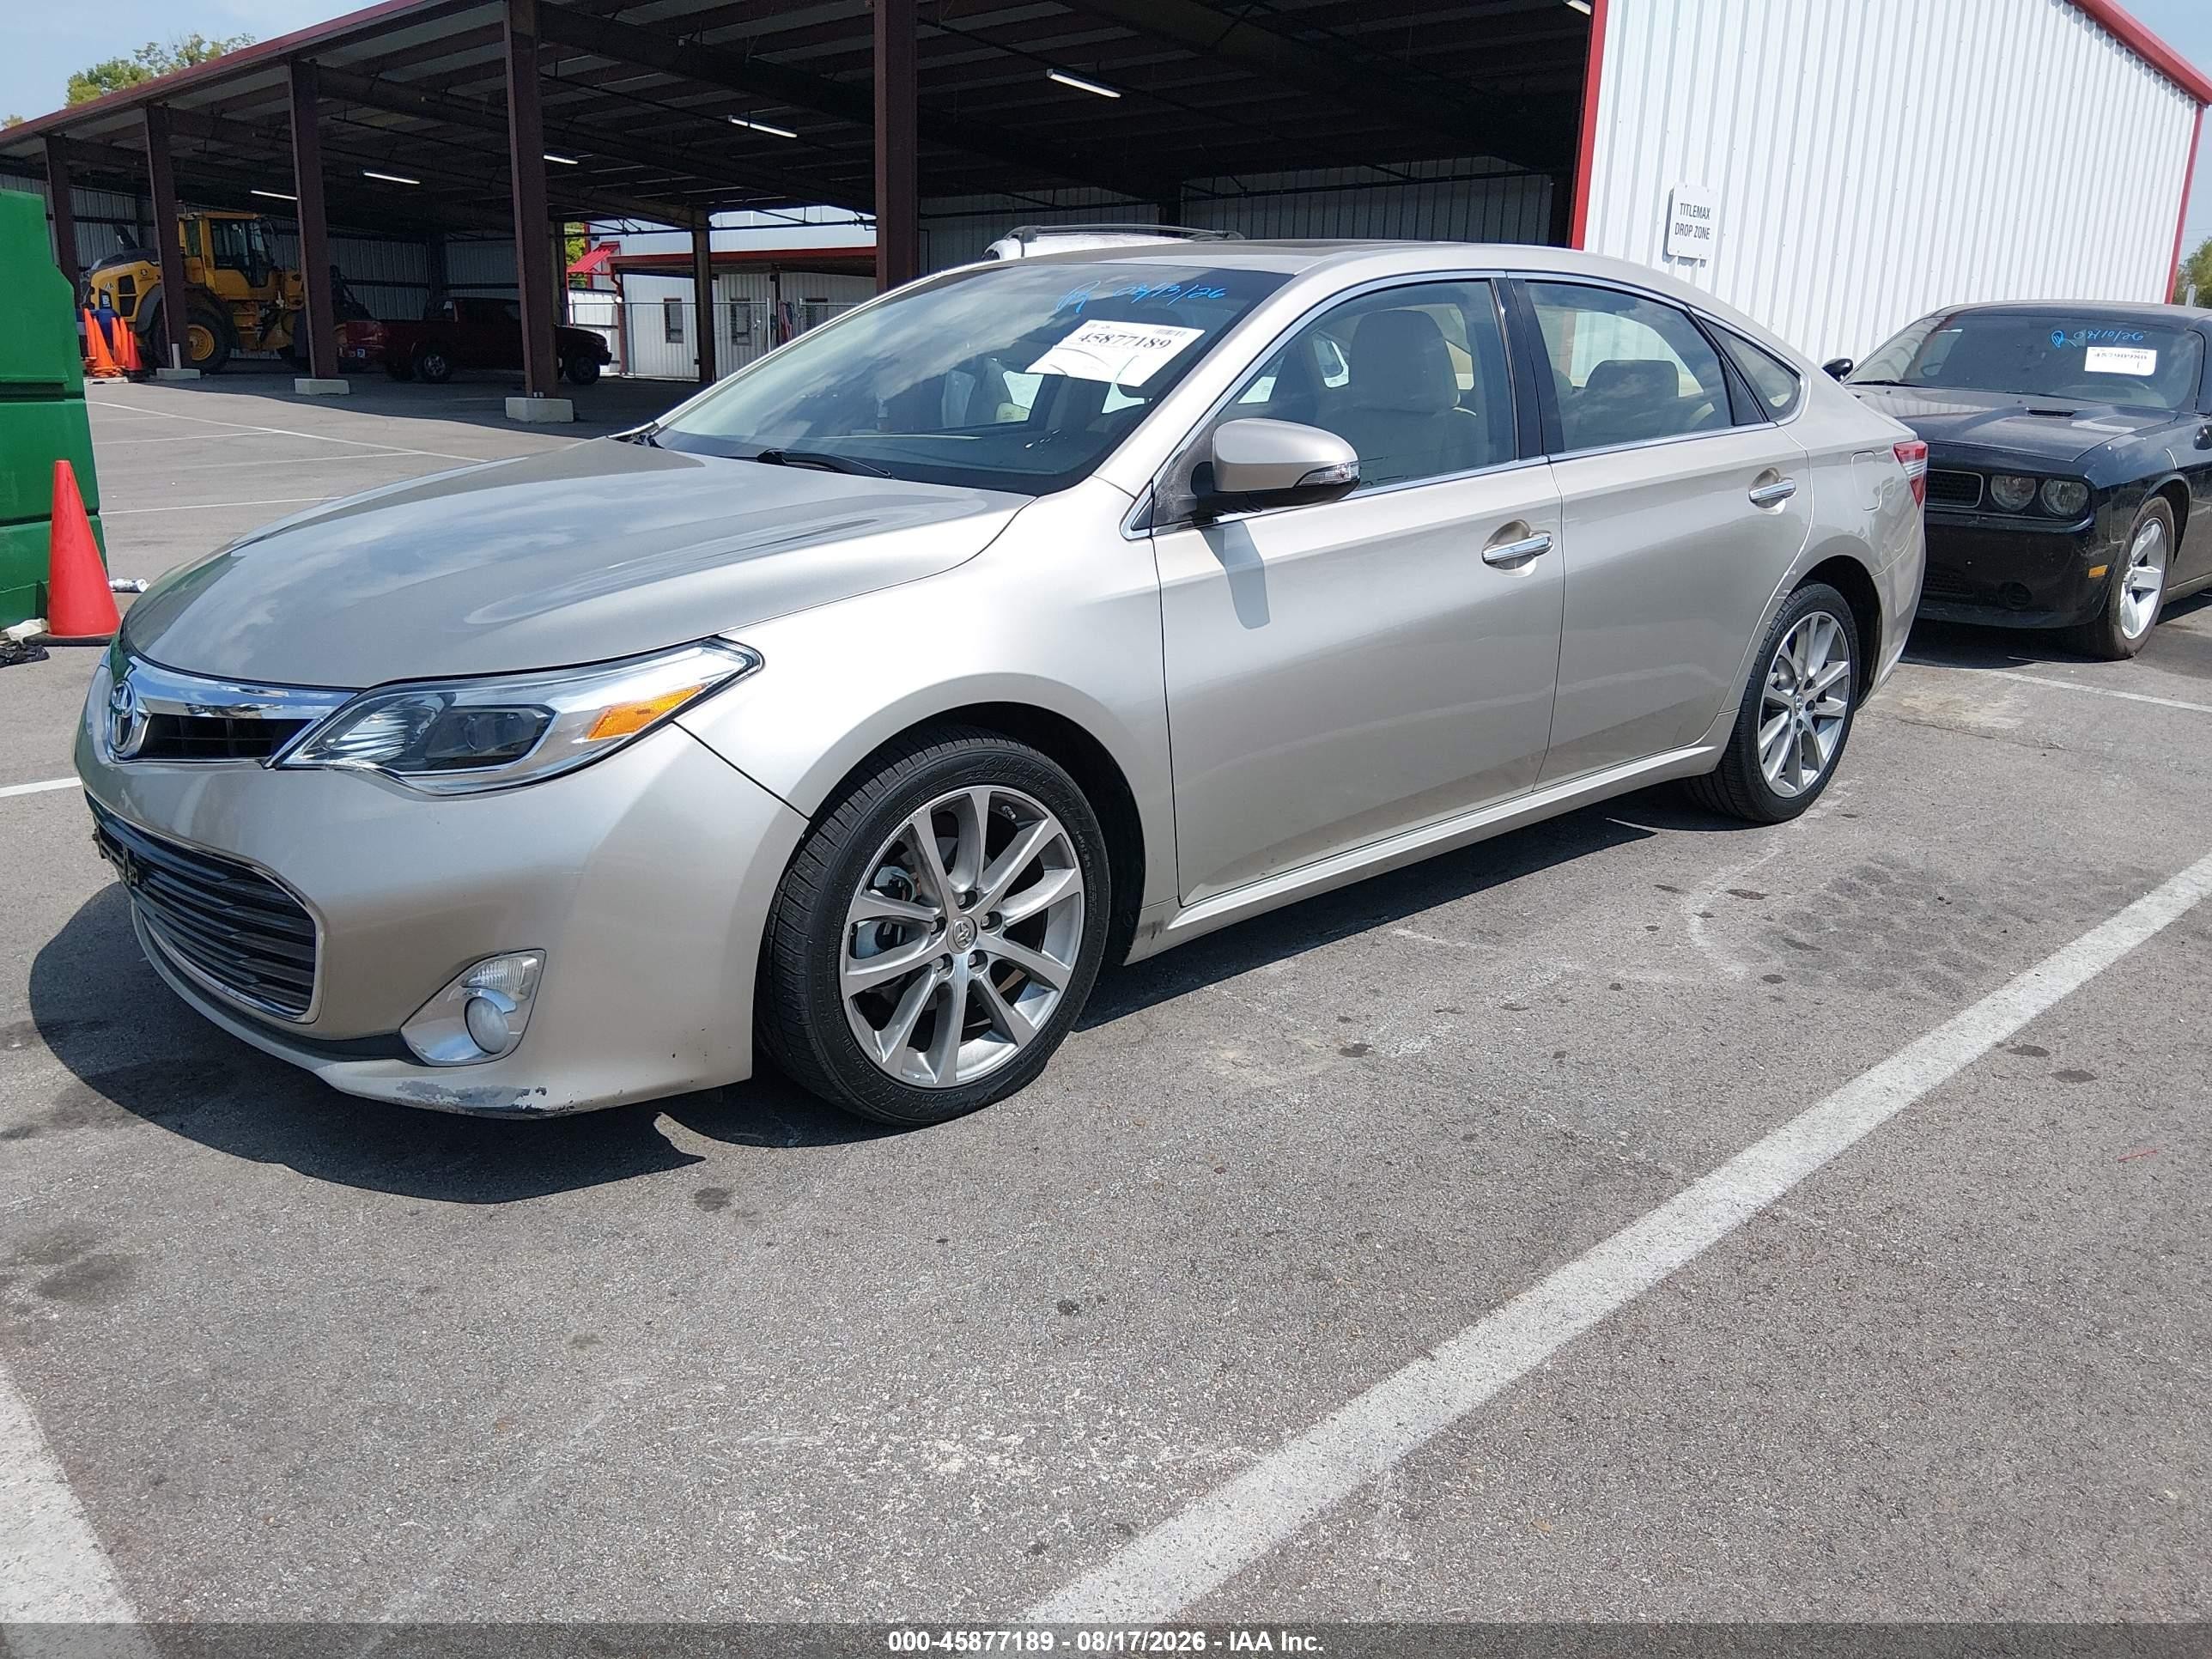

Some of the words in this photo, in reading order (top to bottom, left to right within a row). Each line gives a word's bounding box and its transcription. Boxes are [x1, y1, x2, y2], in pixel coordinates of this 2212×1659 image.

[1680, 203, 1711, 220] TITLEMAX
[1674, 222, 1693, 237] DROP
[1694, 225, 1711, 240] ZONE
[1079, 332, 1171, 349] 45877189
